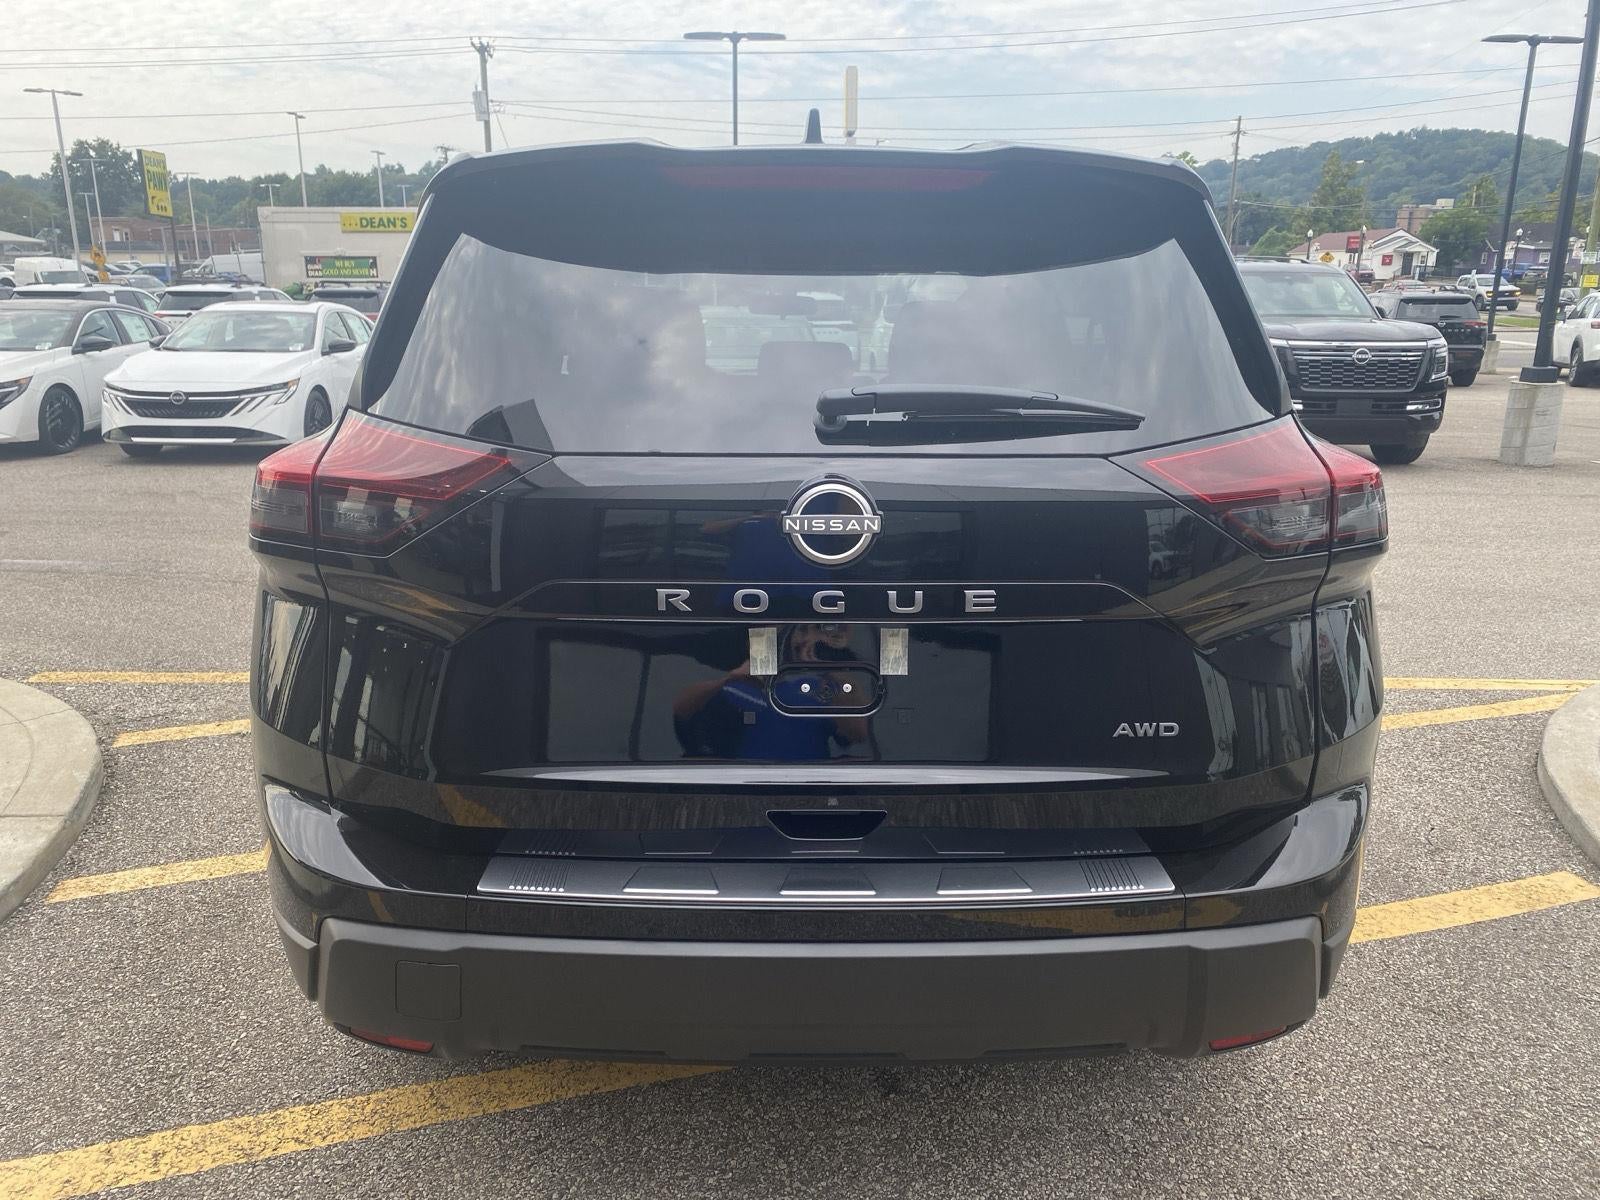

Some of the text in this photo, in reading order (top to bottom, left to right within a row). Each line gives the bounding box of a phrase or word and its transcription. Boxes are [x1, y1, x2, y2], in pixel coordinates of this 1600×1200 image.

[146, 169, 168, 192] PAWN
[359, 216, 408, 229] DEAN'S
[785, 518, 880, 532] NISSAN
[655, 588, 998, 614] ROGUE
[1111, 722, 1180, 738] AWD
